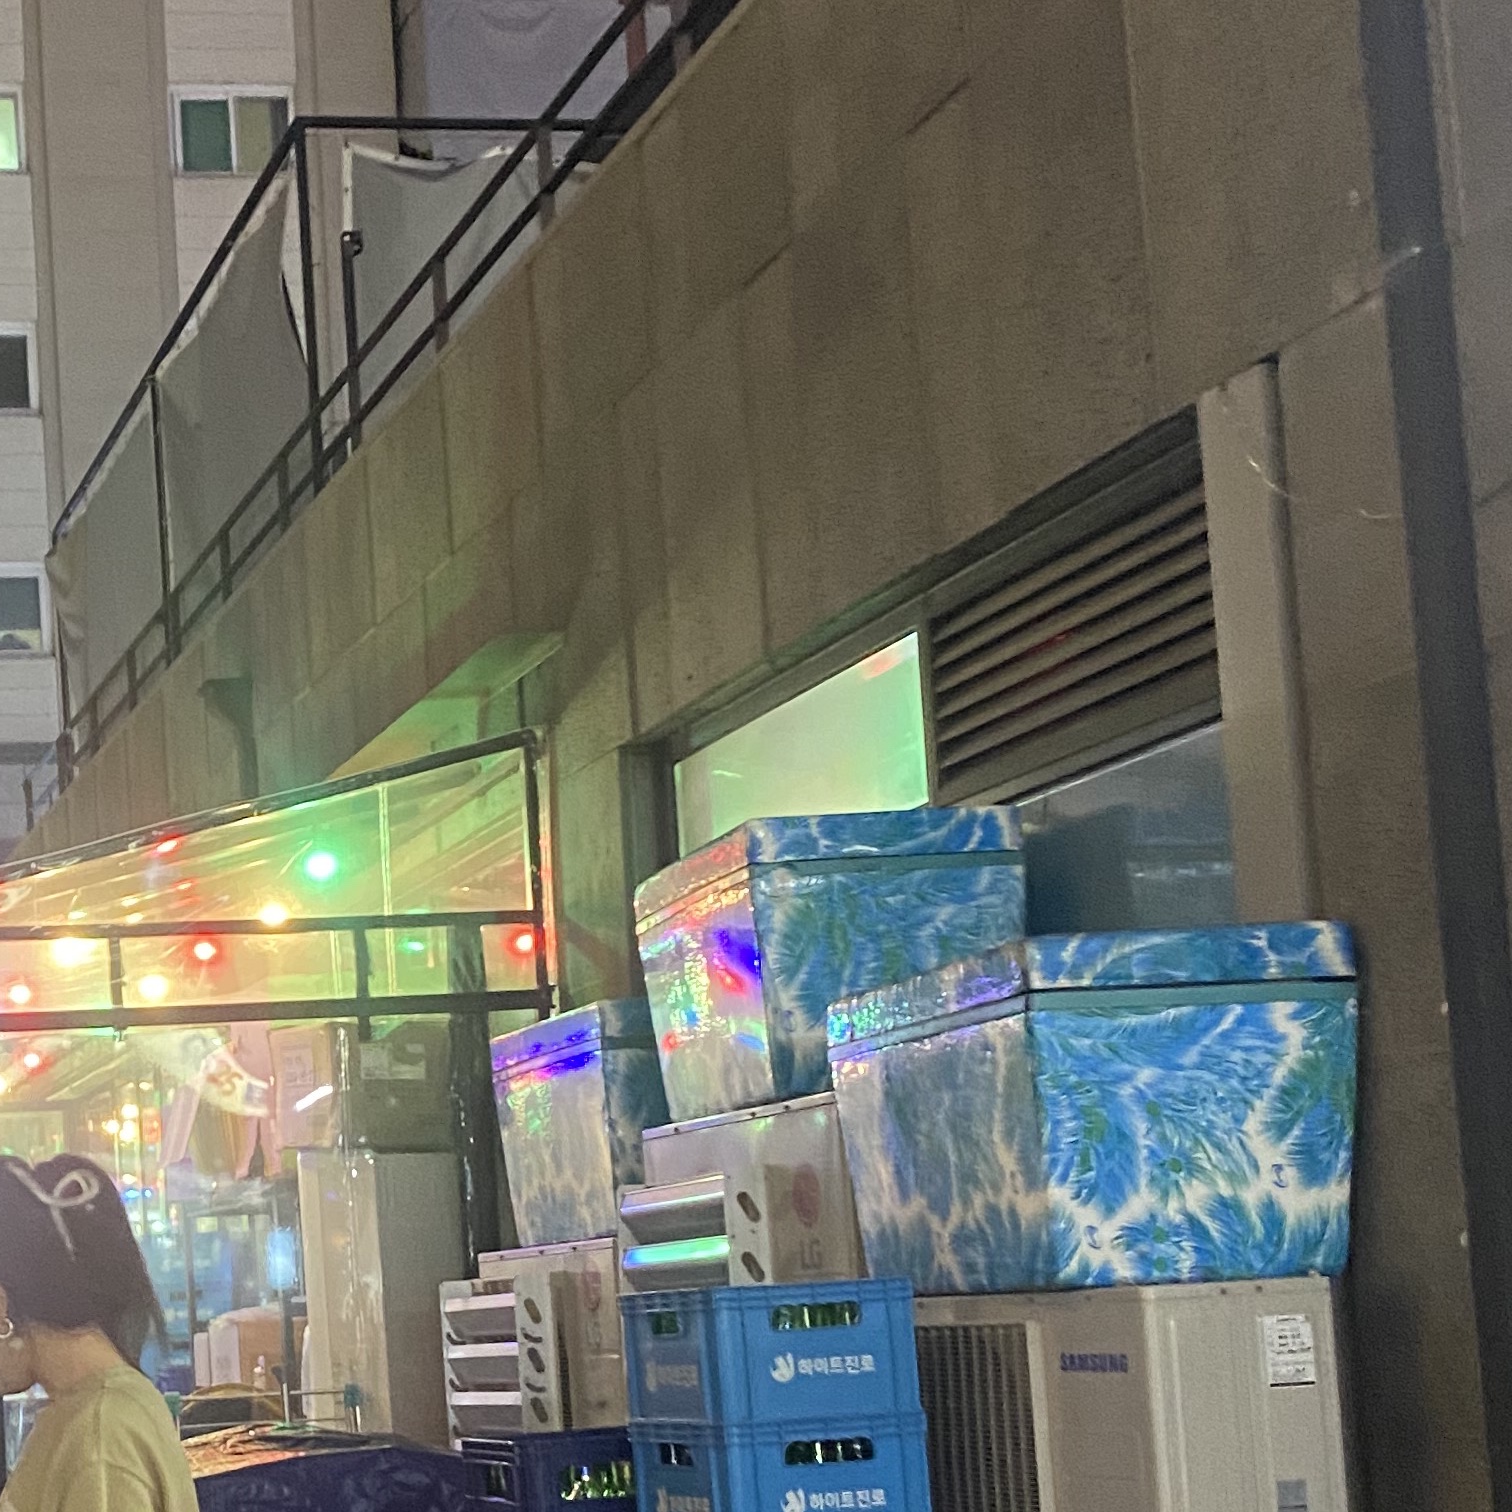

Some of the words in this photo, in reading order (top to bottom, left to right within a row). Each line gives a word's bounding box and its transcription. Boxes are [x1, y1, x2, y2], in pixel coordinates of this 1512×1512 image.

[797, 1354, 876, 1375] 하이트진로
[1060, 1352, 1128, 1373] SAMSUNG
[809, 1488, 887, 1511] 하이트진로
